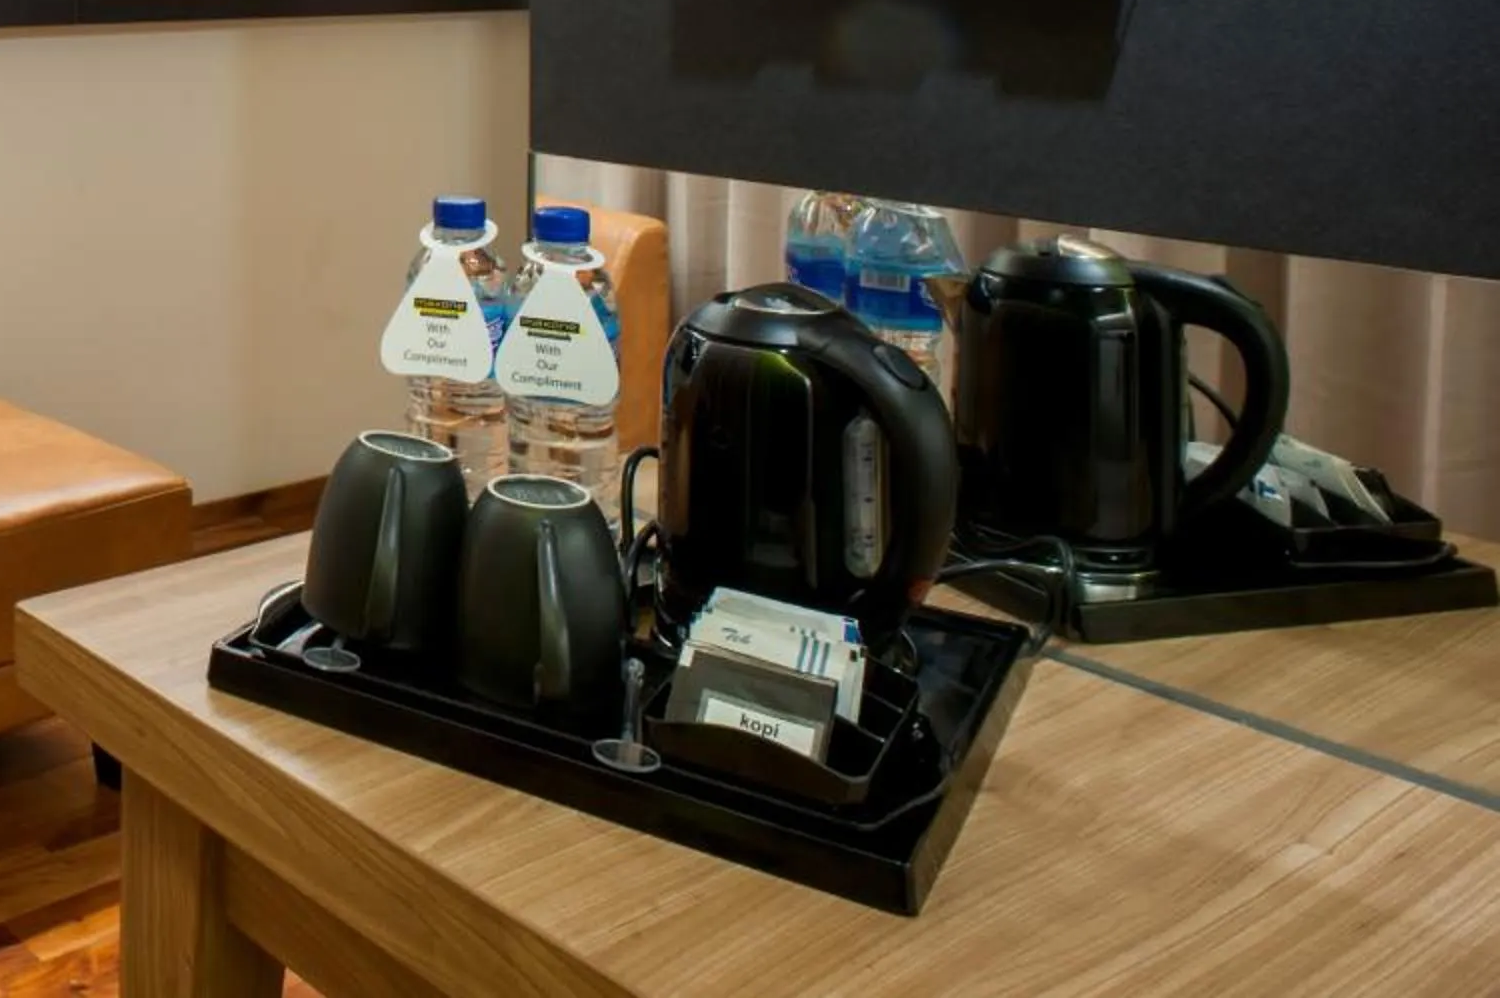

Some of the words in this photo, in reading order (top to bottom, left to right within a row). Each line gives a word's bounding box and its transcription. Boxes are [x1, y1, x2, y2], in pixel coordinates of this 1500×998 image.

[426, 322, 450, 334] With
[426, 337, 447, 349] Our
[535, 343, 562, 356] With
[404, 352, 467, 367] Compliment
[536, 359, 560, 372] Our
[511, 371, 583, 391] Compliment
[740, 713, 780, 738] kopi
